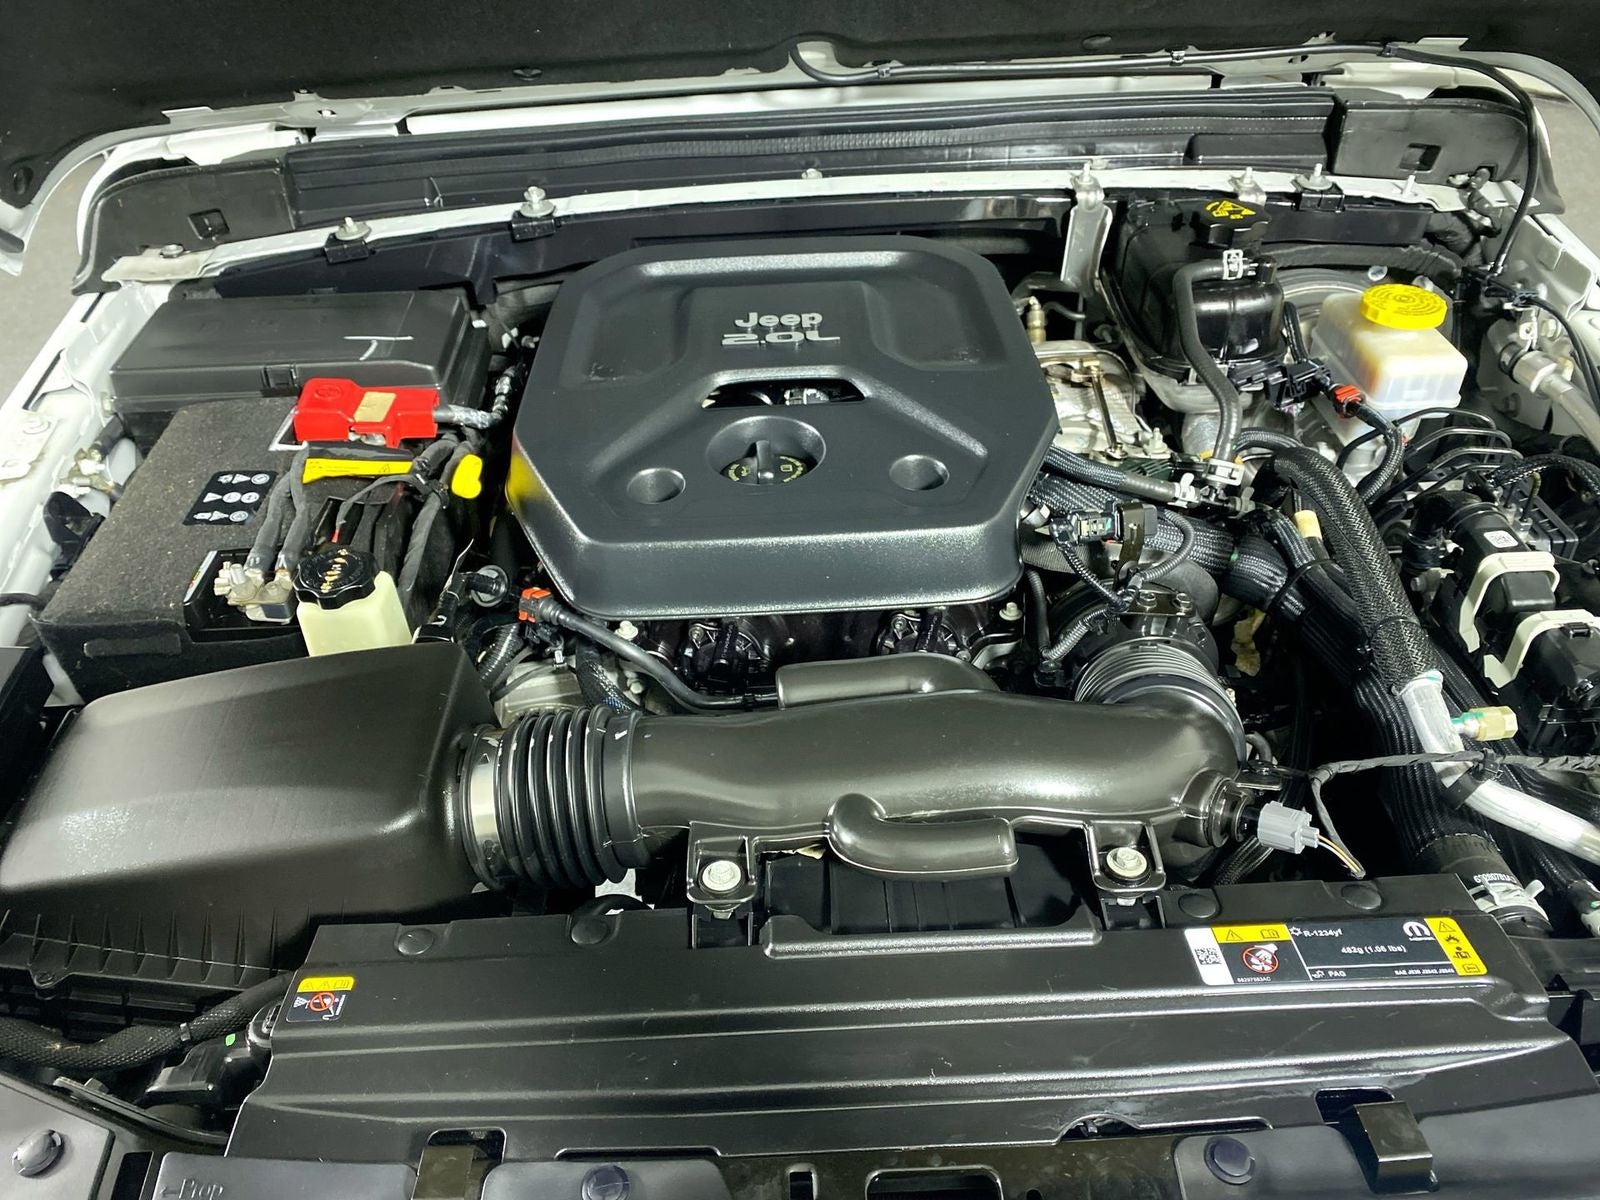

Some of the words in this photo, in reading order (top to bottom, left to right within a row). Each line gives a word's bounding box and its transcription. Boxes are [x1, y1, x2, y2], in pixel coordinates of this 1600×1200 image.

[734, 312, 823, 328] Jeep
[721, 330, 840, 345] 2.0L
[1303, 928, 1343, 938] R-1234yf
